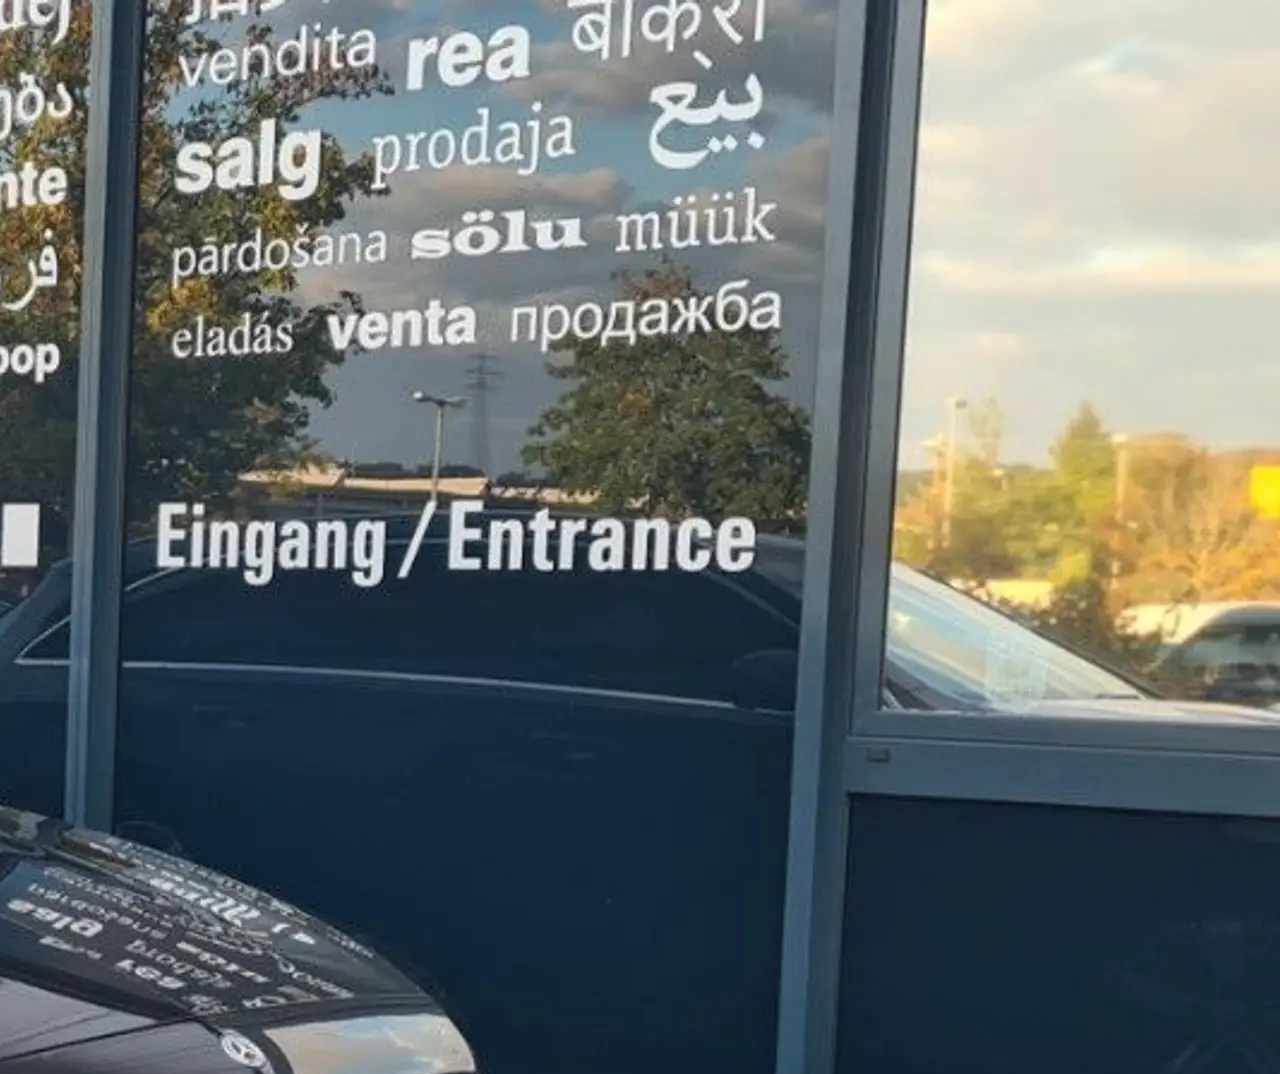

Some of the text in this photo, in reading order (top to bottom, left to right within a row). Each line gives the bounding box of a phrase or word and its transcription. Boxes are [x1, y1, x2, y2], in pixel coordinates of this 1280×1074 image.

[178, 21, 530, 90] vendita rea
[174, 102, 576, 200] salg prodaja
[410, 210, 586, 260] sölu
[614, 188, 778, 252] müük
[171, 299, 476, 358] eladás venta
[510, 279, 781, 353] продажба
[156, 502, 385, 586] Eingang
[448, 500, 756, 573] Entrance
